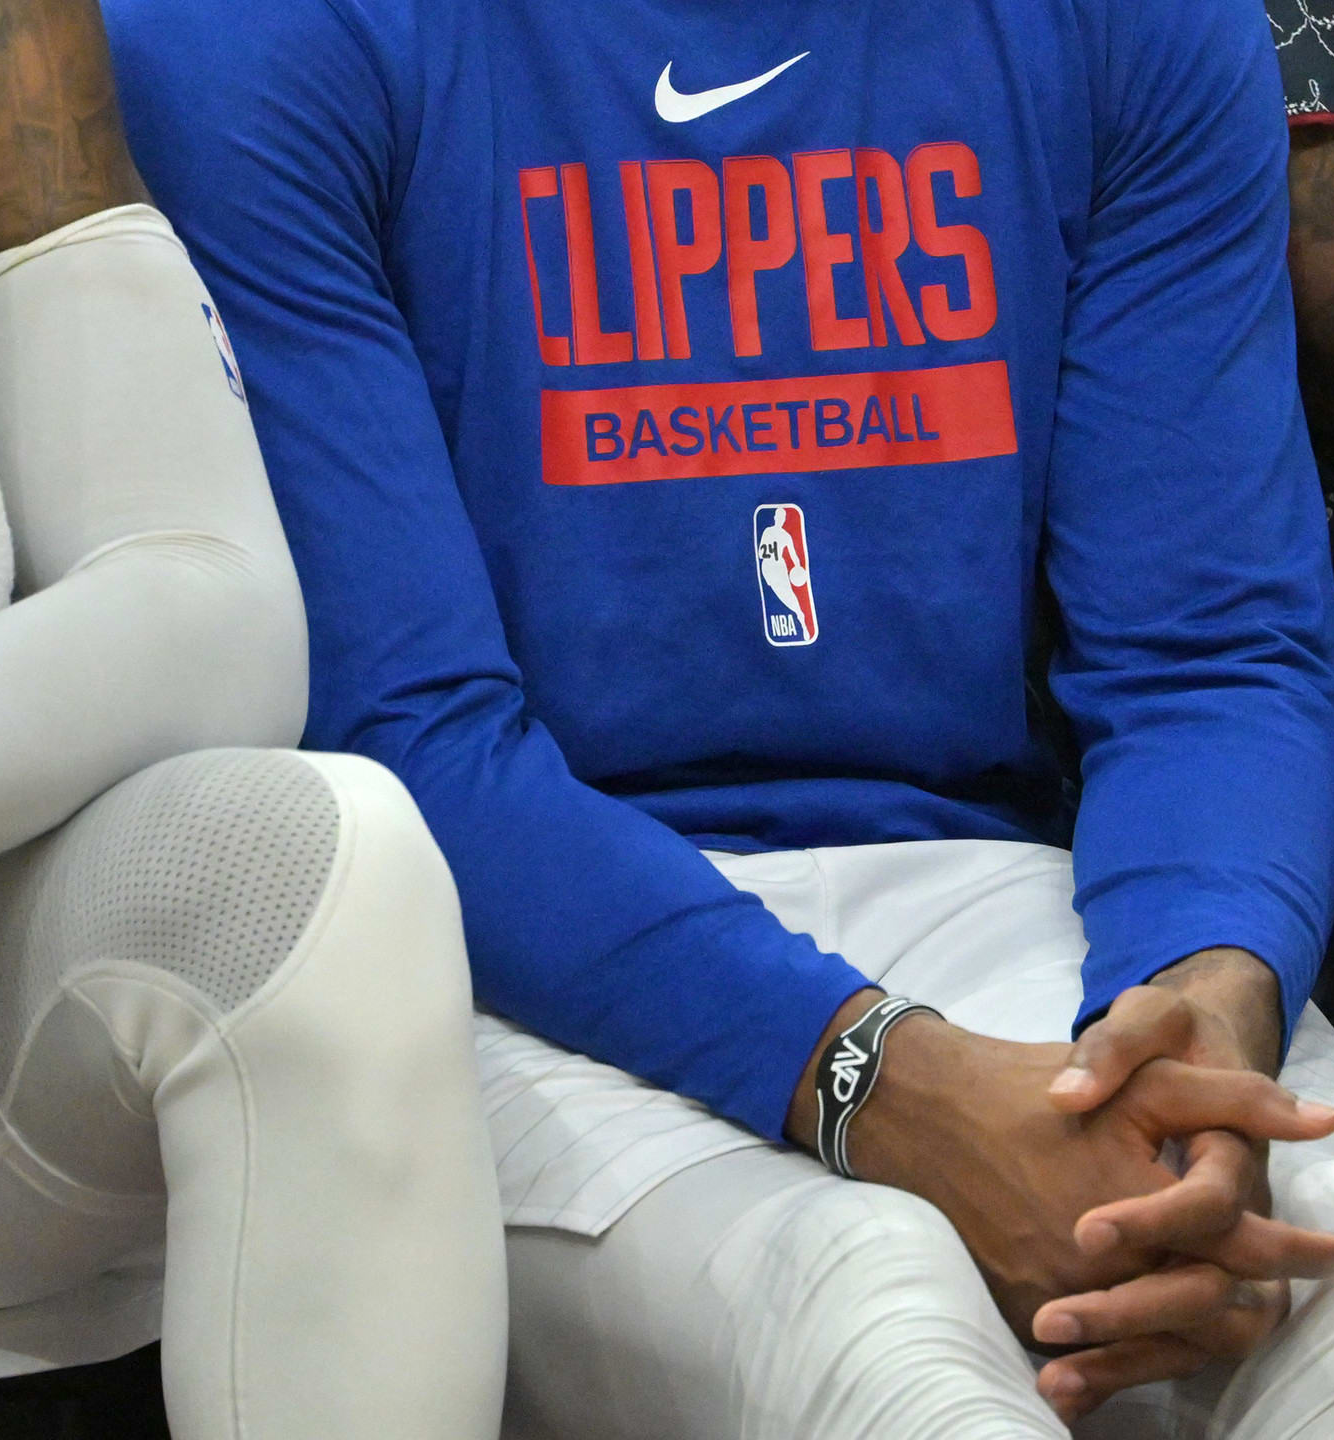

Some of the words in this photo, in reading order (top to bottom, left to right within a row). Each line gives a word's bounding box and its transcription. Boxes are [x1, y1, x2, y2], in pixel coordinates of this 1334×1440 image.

[518, 141, 998, 367] CLIPPERS
[584, 394, 940, 462] BASKETBALL
[759, 541, 779, 561] 24
[770, 614, 798, 637] NBA
